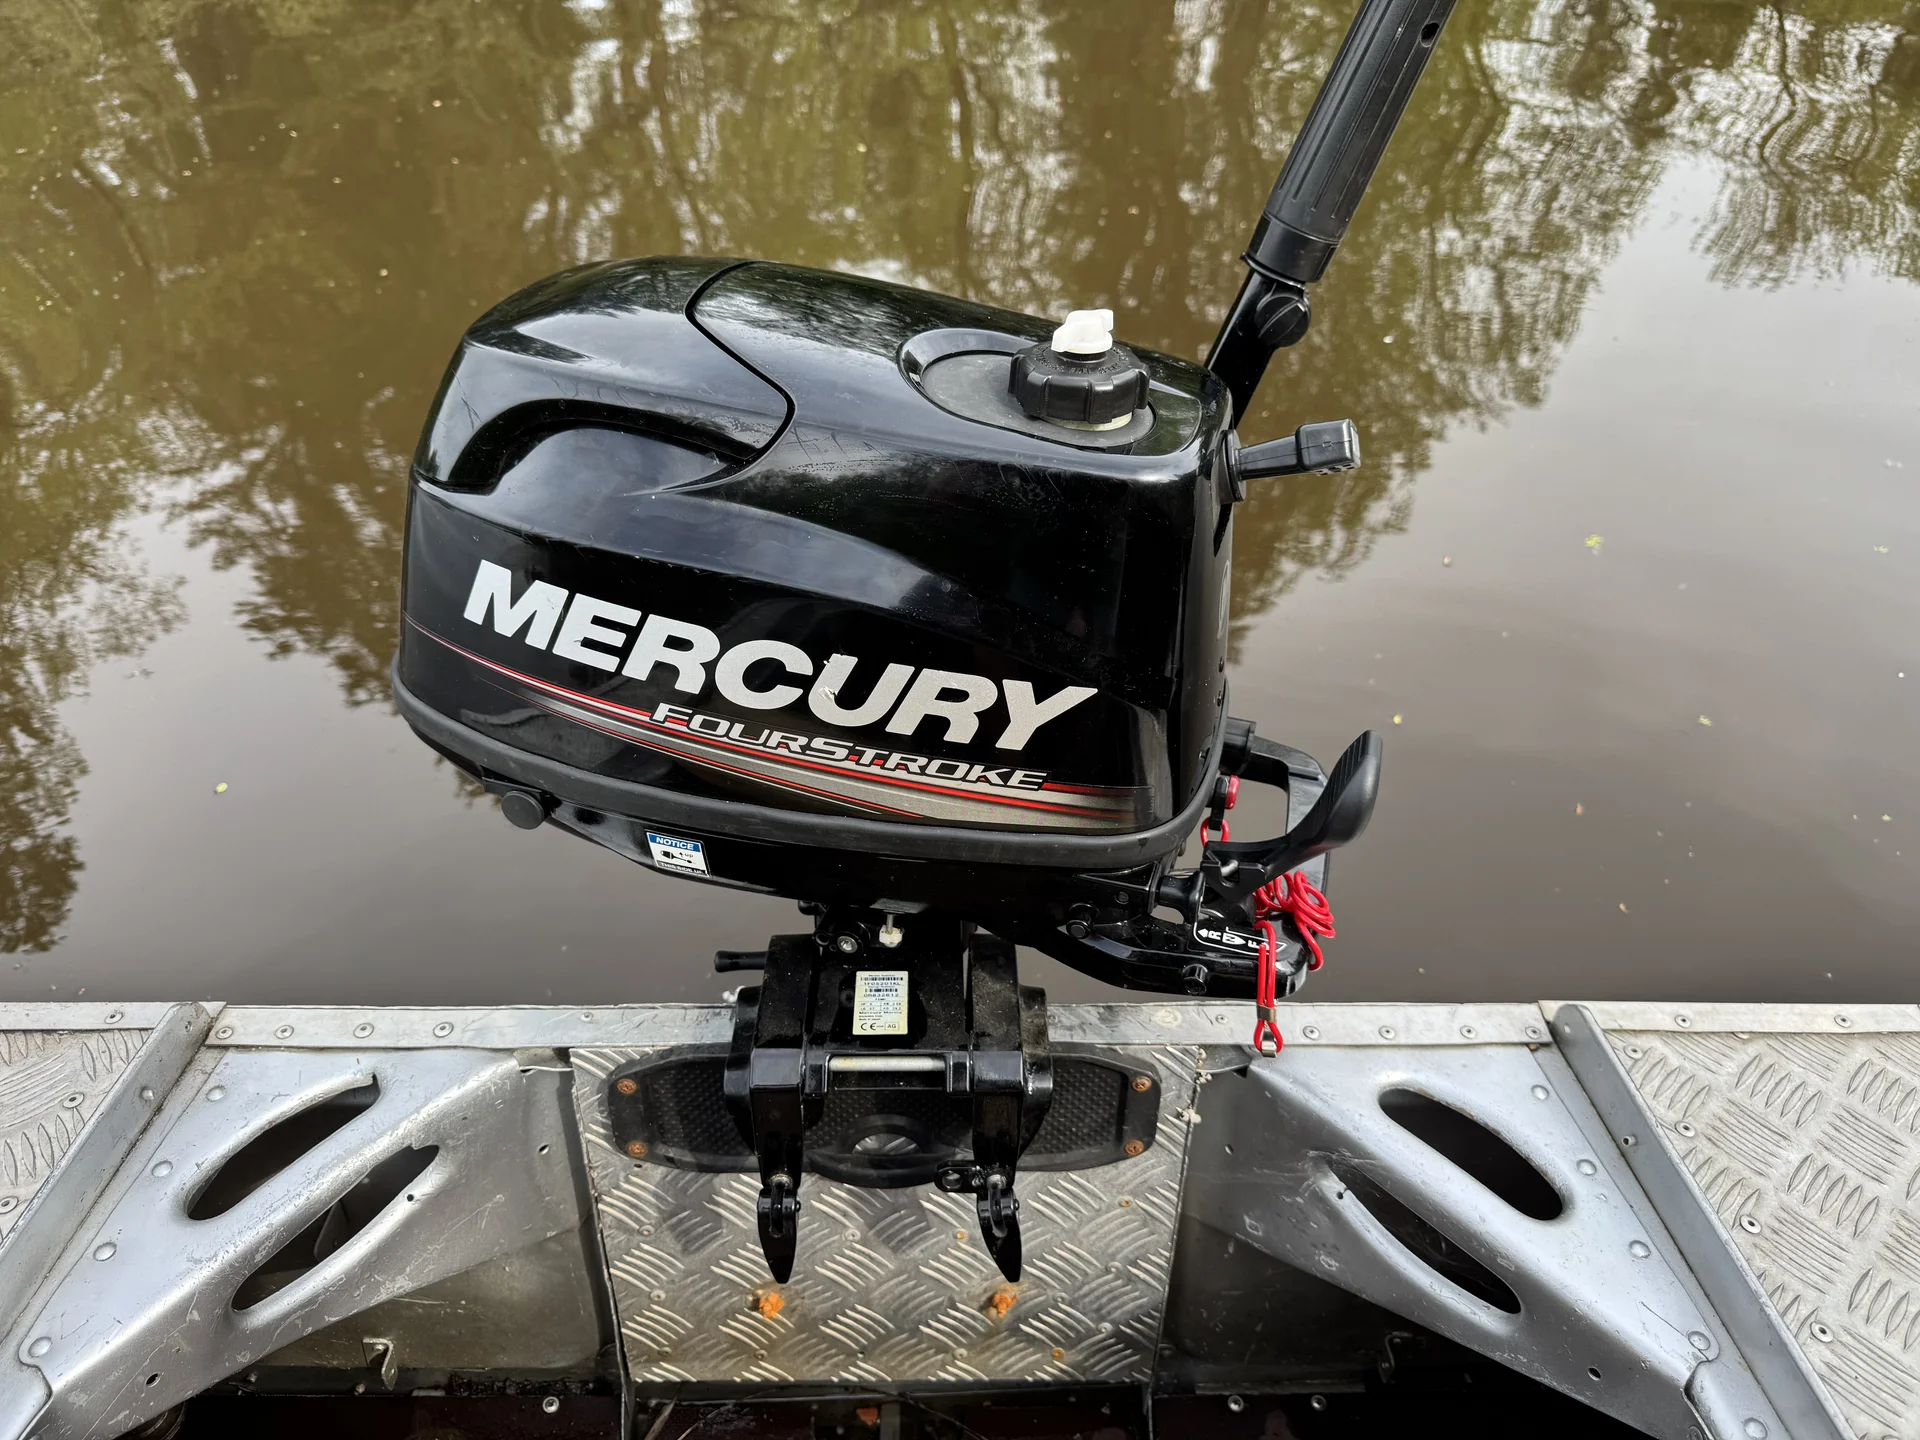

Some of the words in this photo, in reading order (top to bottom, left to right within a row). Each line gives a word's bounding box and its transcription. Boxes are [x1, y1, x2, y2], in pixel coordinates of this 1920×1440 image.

[463, 559, 1098, 751] MERCURY
[652, 702, 1048, 790] FOURSTROKE
[656, 836, 694, 850] NOTICE
[1208, 930, 1222, 940] R
[1248, 940, 1260, 949] F
